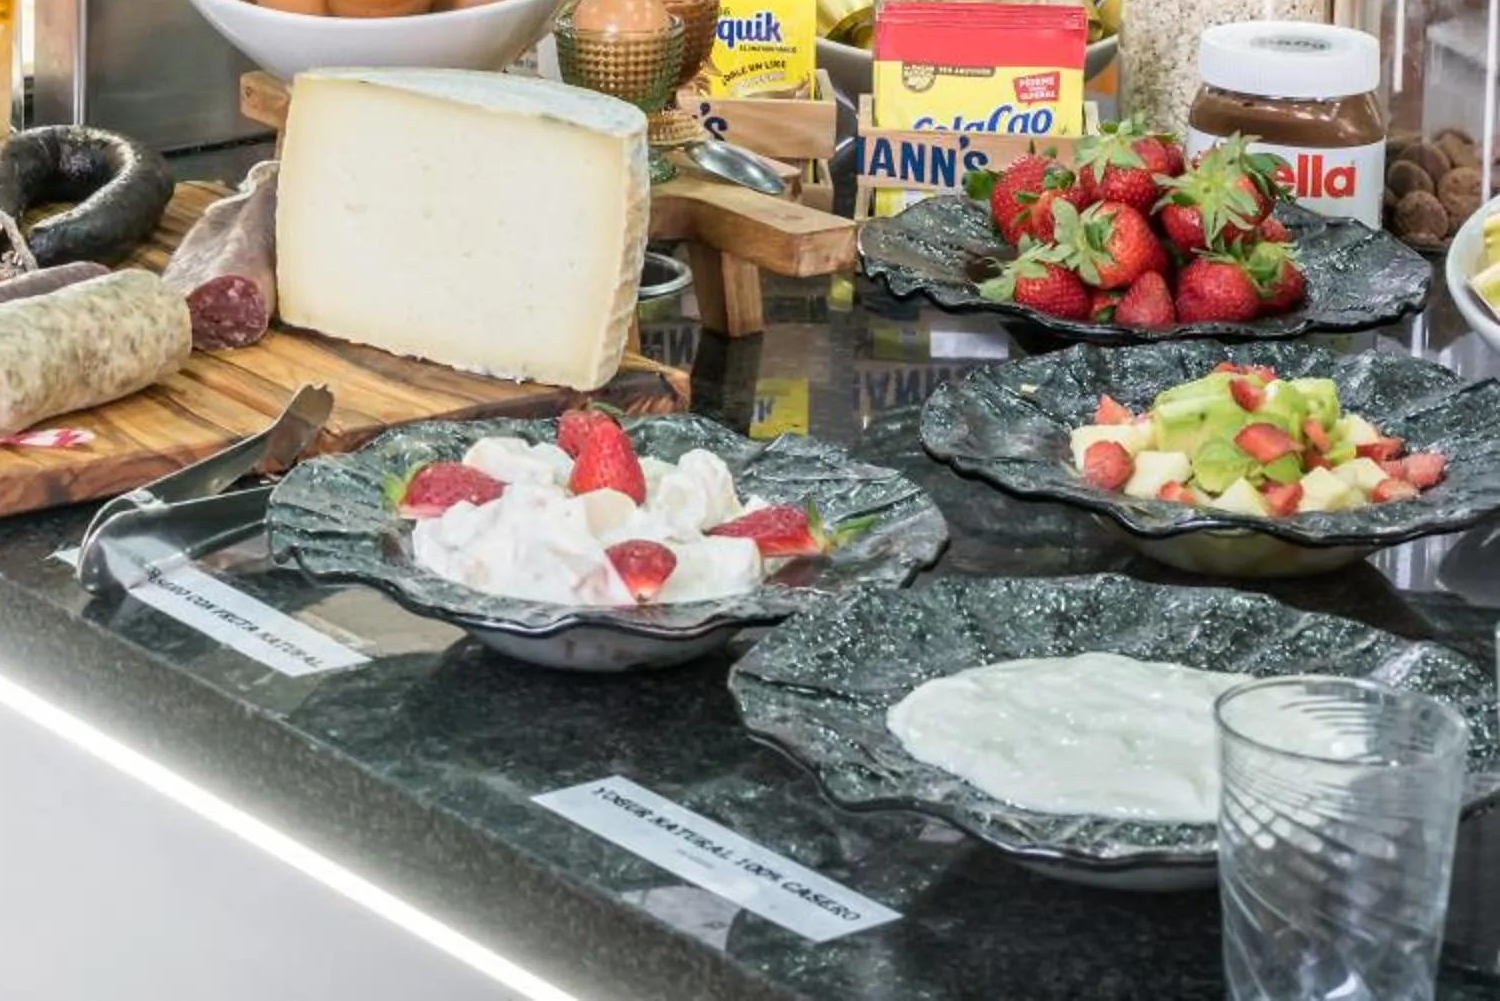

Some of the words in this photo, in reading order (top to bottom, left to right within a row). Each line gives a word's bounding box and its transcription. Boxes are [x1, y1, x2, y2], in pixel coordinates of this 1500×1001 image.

[717, 11, 782, 49] quik
[1273, 153, 1356, 198] ella
[781, 880, 862, 922] CASERO
